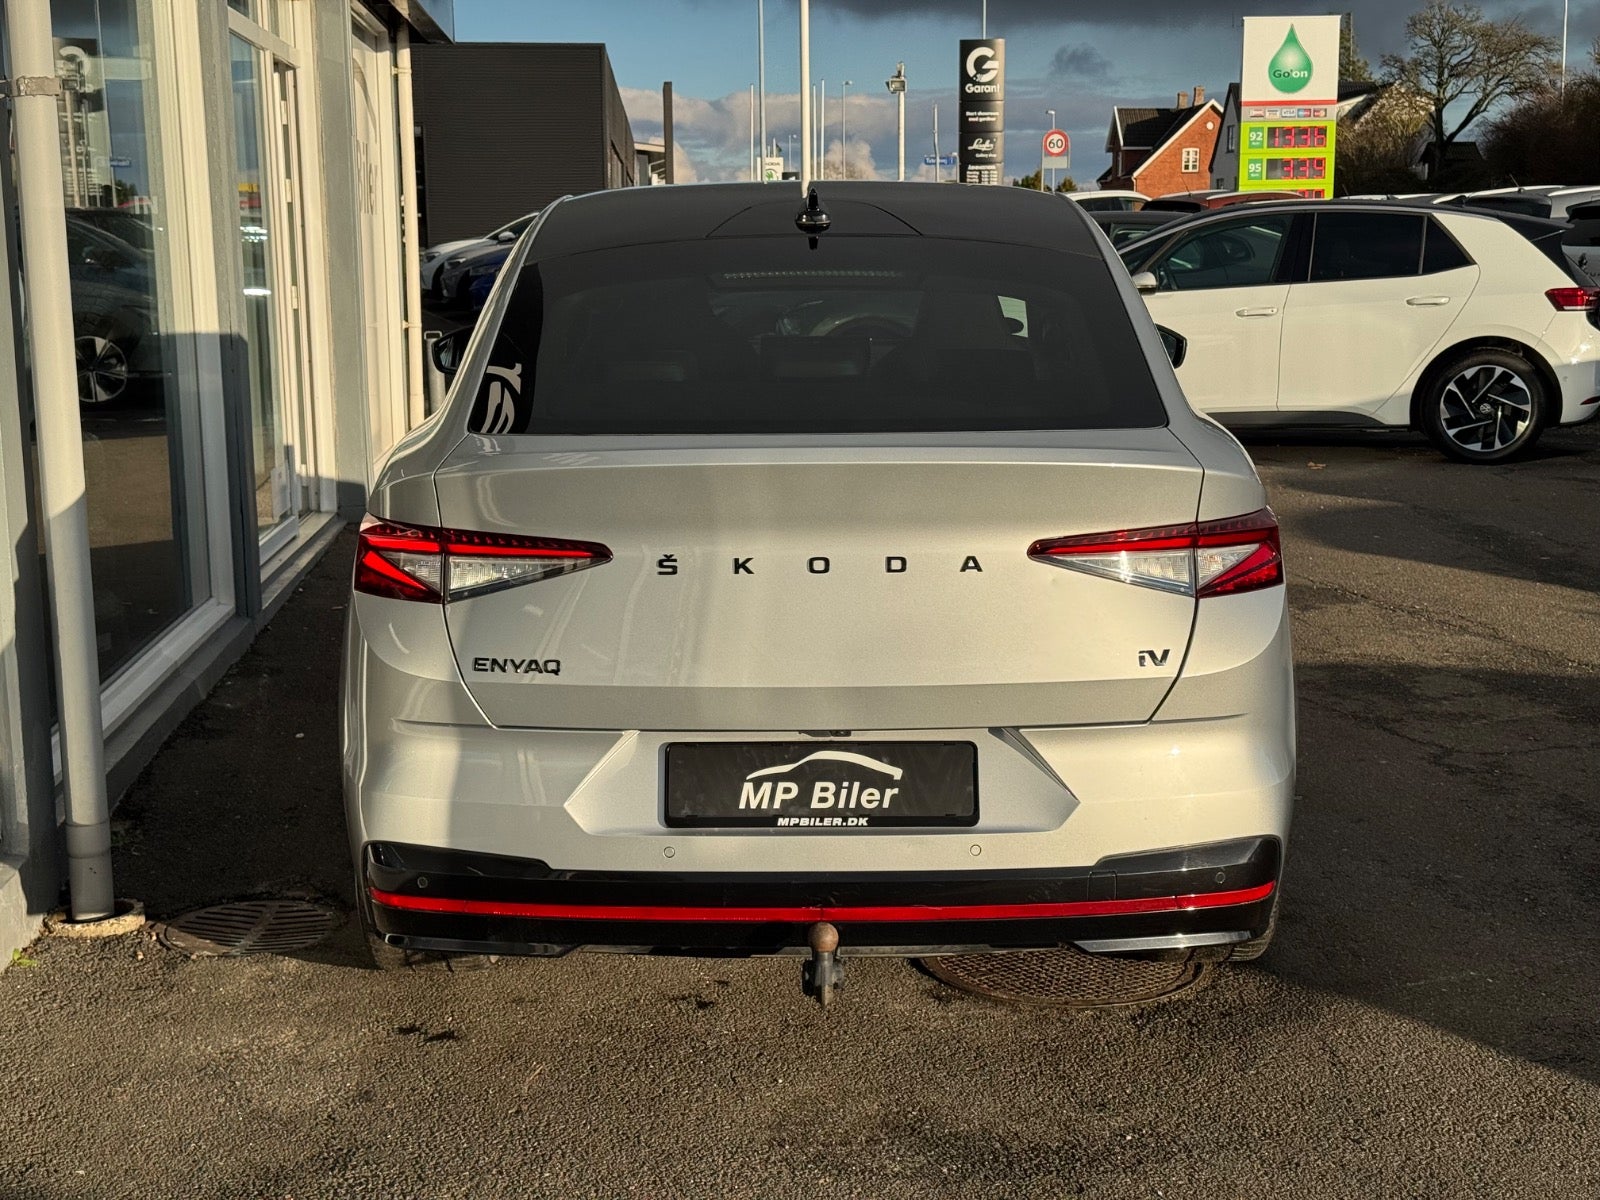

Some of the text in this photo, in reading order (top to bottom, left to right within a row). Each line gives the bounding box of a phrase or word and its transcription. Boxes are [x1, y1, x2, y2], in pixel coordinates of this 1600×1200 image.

[965, 83, 1000, 93] Garant
[1249, 132, 1263, 141] 92
[1048, 138, 1064, 149] 60
[1248, 163, 1262, 173] 95
[656, 553, 983, 576] ŠKODA
[472, 657, 561, 675] ENYAQ
[738, 781, 899, 809] MP Biler
[777, 817, 868, 827] MPBILER.DK
